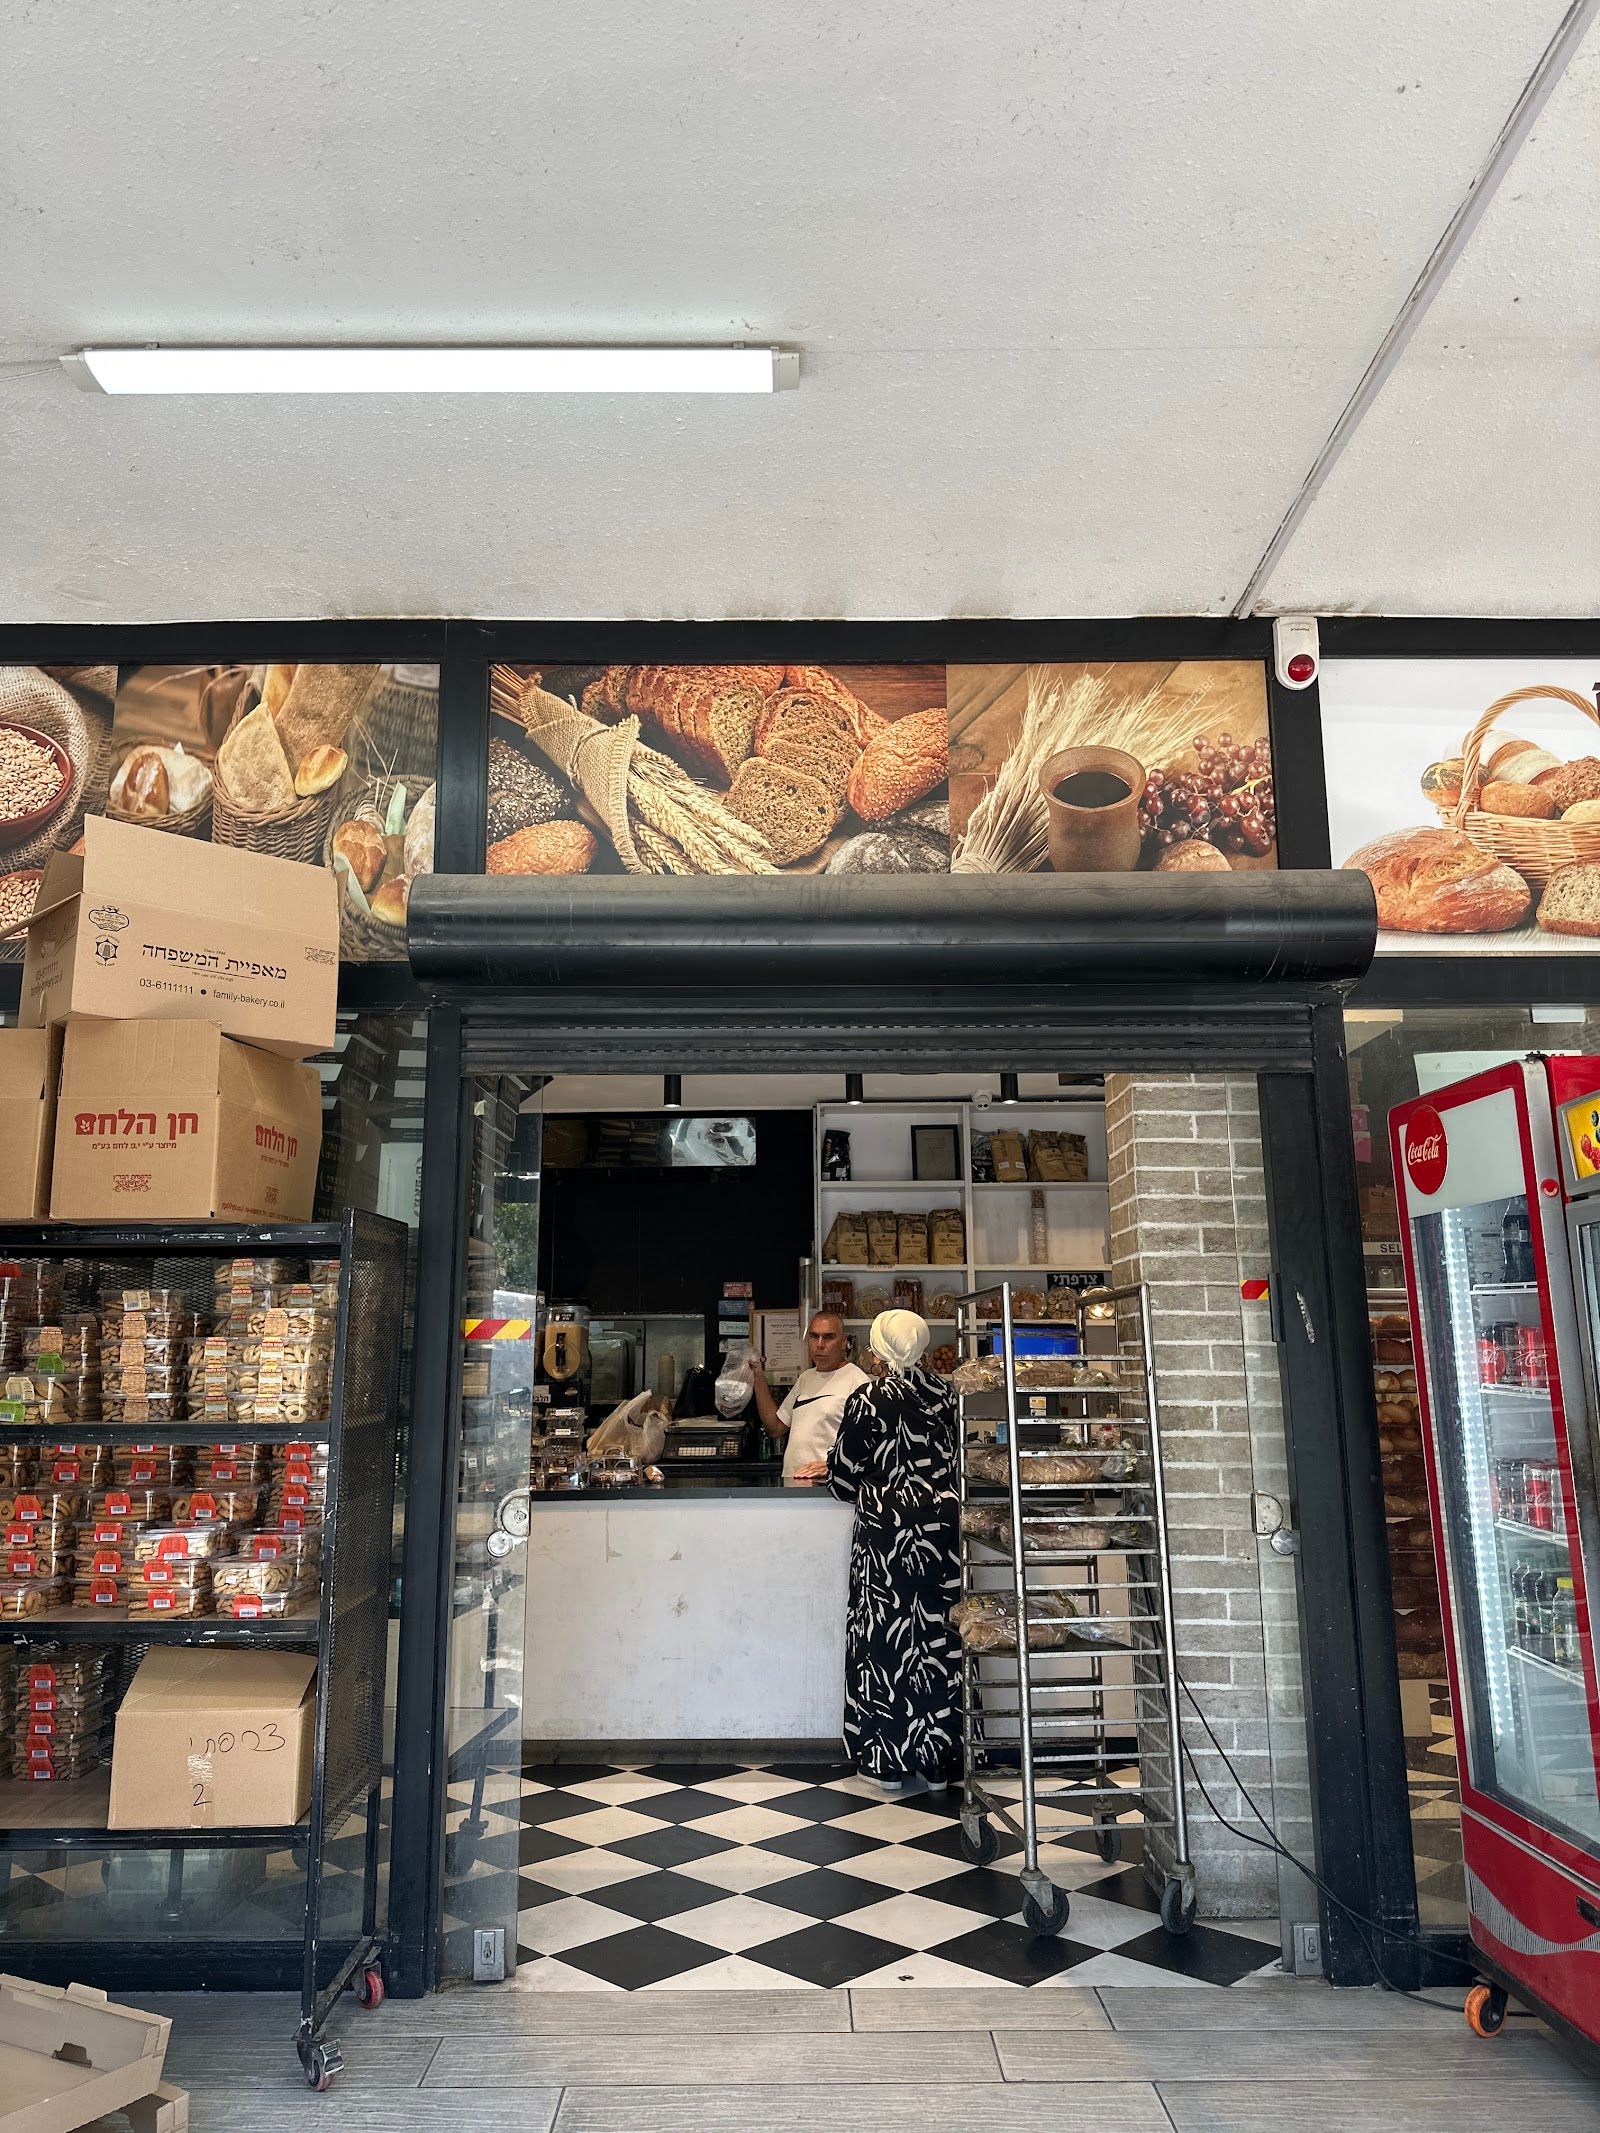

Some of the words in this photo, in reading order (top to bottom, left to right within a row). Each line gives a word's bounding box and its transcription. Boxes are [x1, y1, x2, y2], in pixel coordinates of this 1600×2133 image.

[142, 943, 219, 968] המשפחה
[224, 957, 287, 980] מאפיית
[139, 978, 194, 995] 03-6111111
[74, 1108, 157, 1136] הלחם
[167, 1111, 199, 1141] חן
[255, 1124, 285, 1154] הלחם
[287, 1135, 298, 1161] חן
[1052, 1274, 1098, 1286] צרפתי
[192, 1783, 212, 1807] 2
